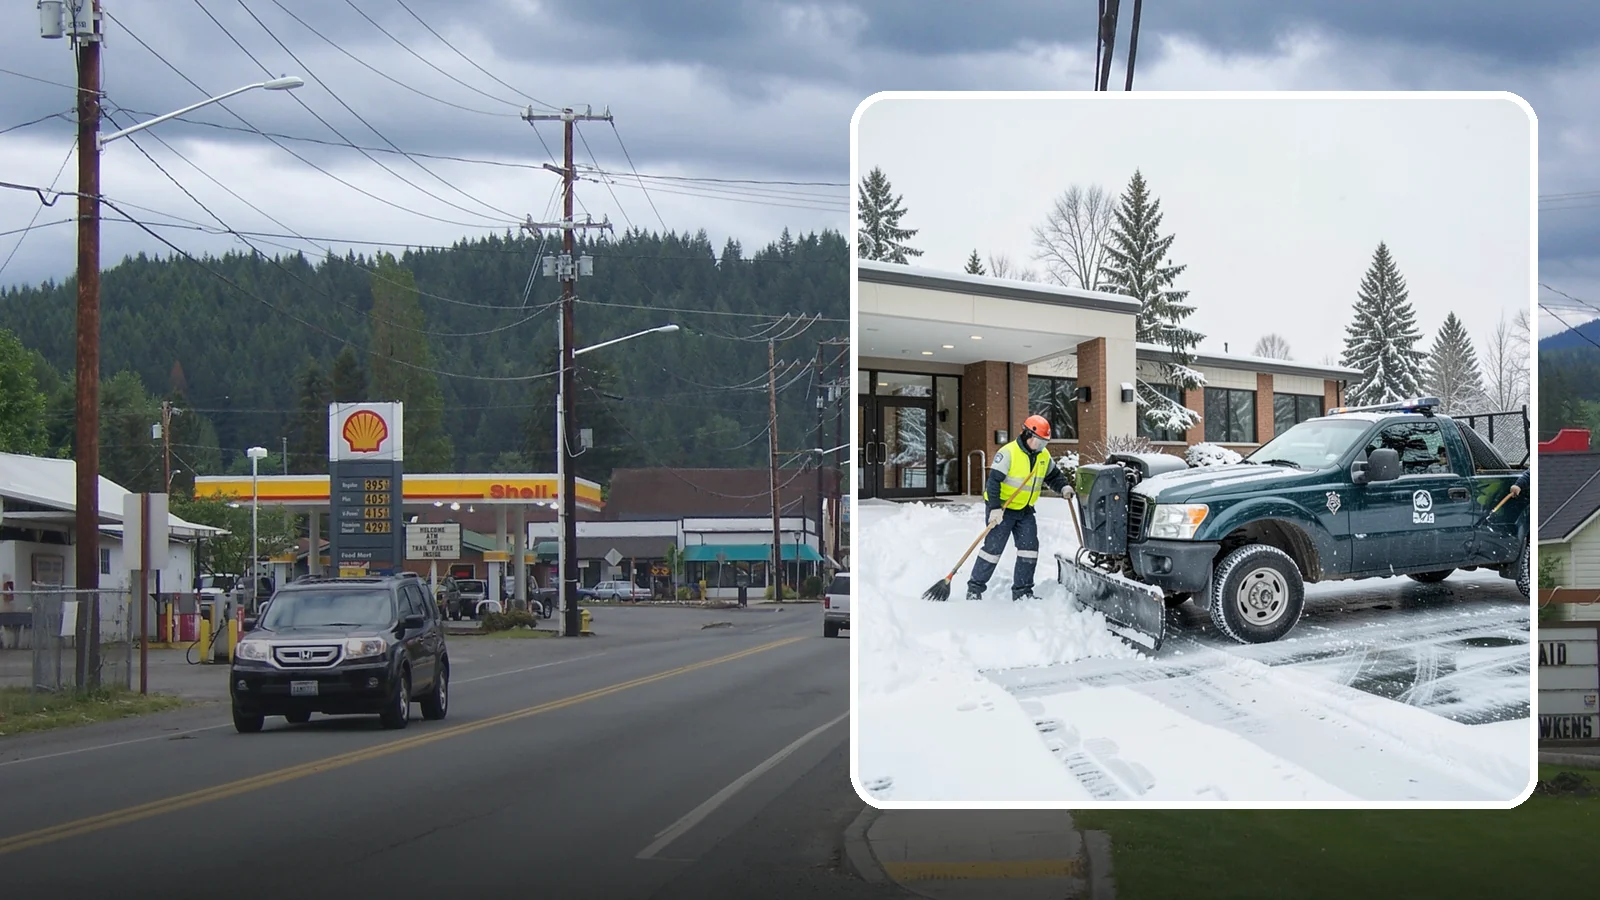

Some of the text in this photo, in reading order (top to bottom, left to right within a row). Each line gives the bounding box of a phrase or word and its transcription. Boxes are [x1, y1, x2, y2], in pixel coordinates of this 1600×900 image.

[366, 480, 384, 490] 395
[490, 484, 547, 499] Shell
[366, 494, 384, 504] 405
[366, 508, 384, 518] 415
[366, 522, 384, 533] 429
[1539, 643, 1567, 666] AID
